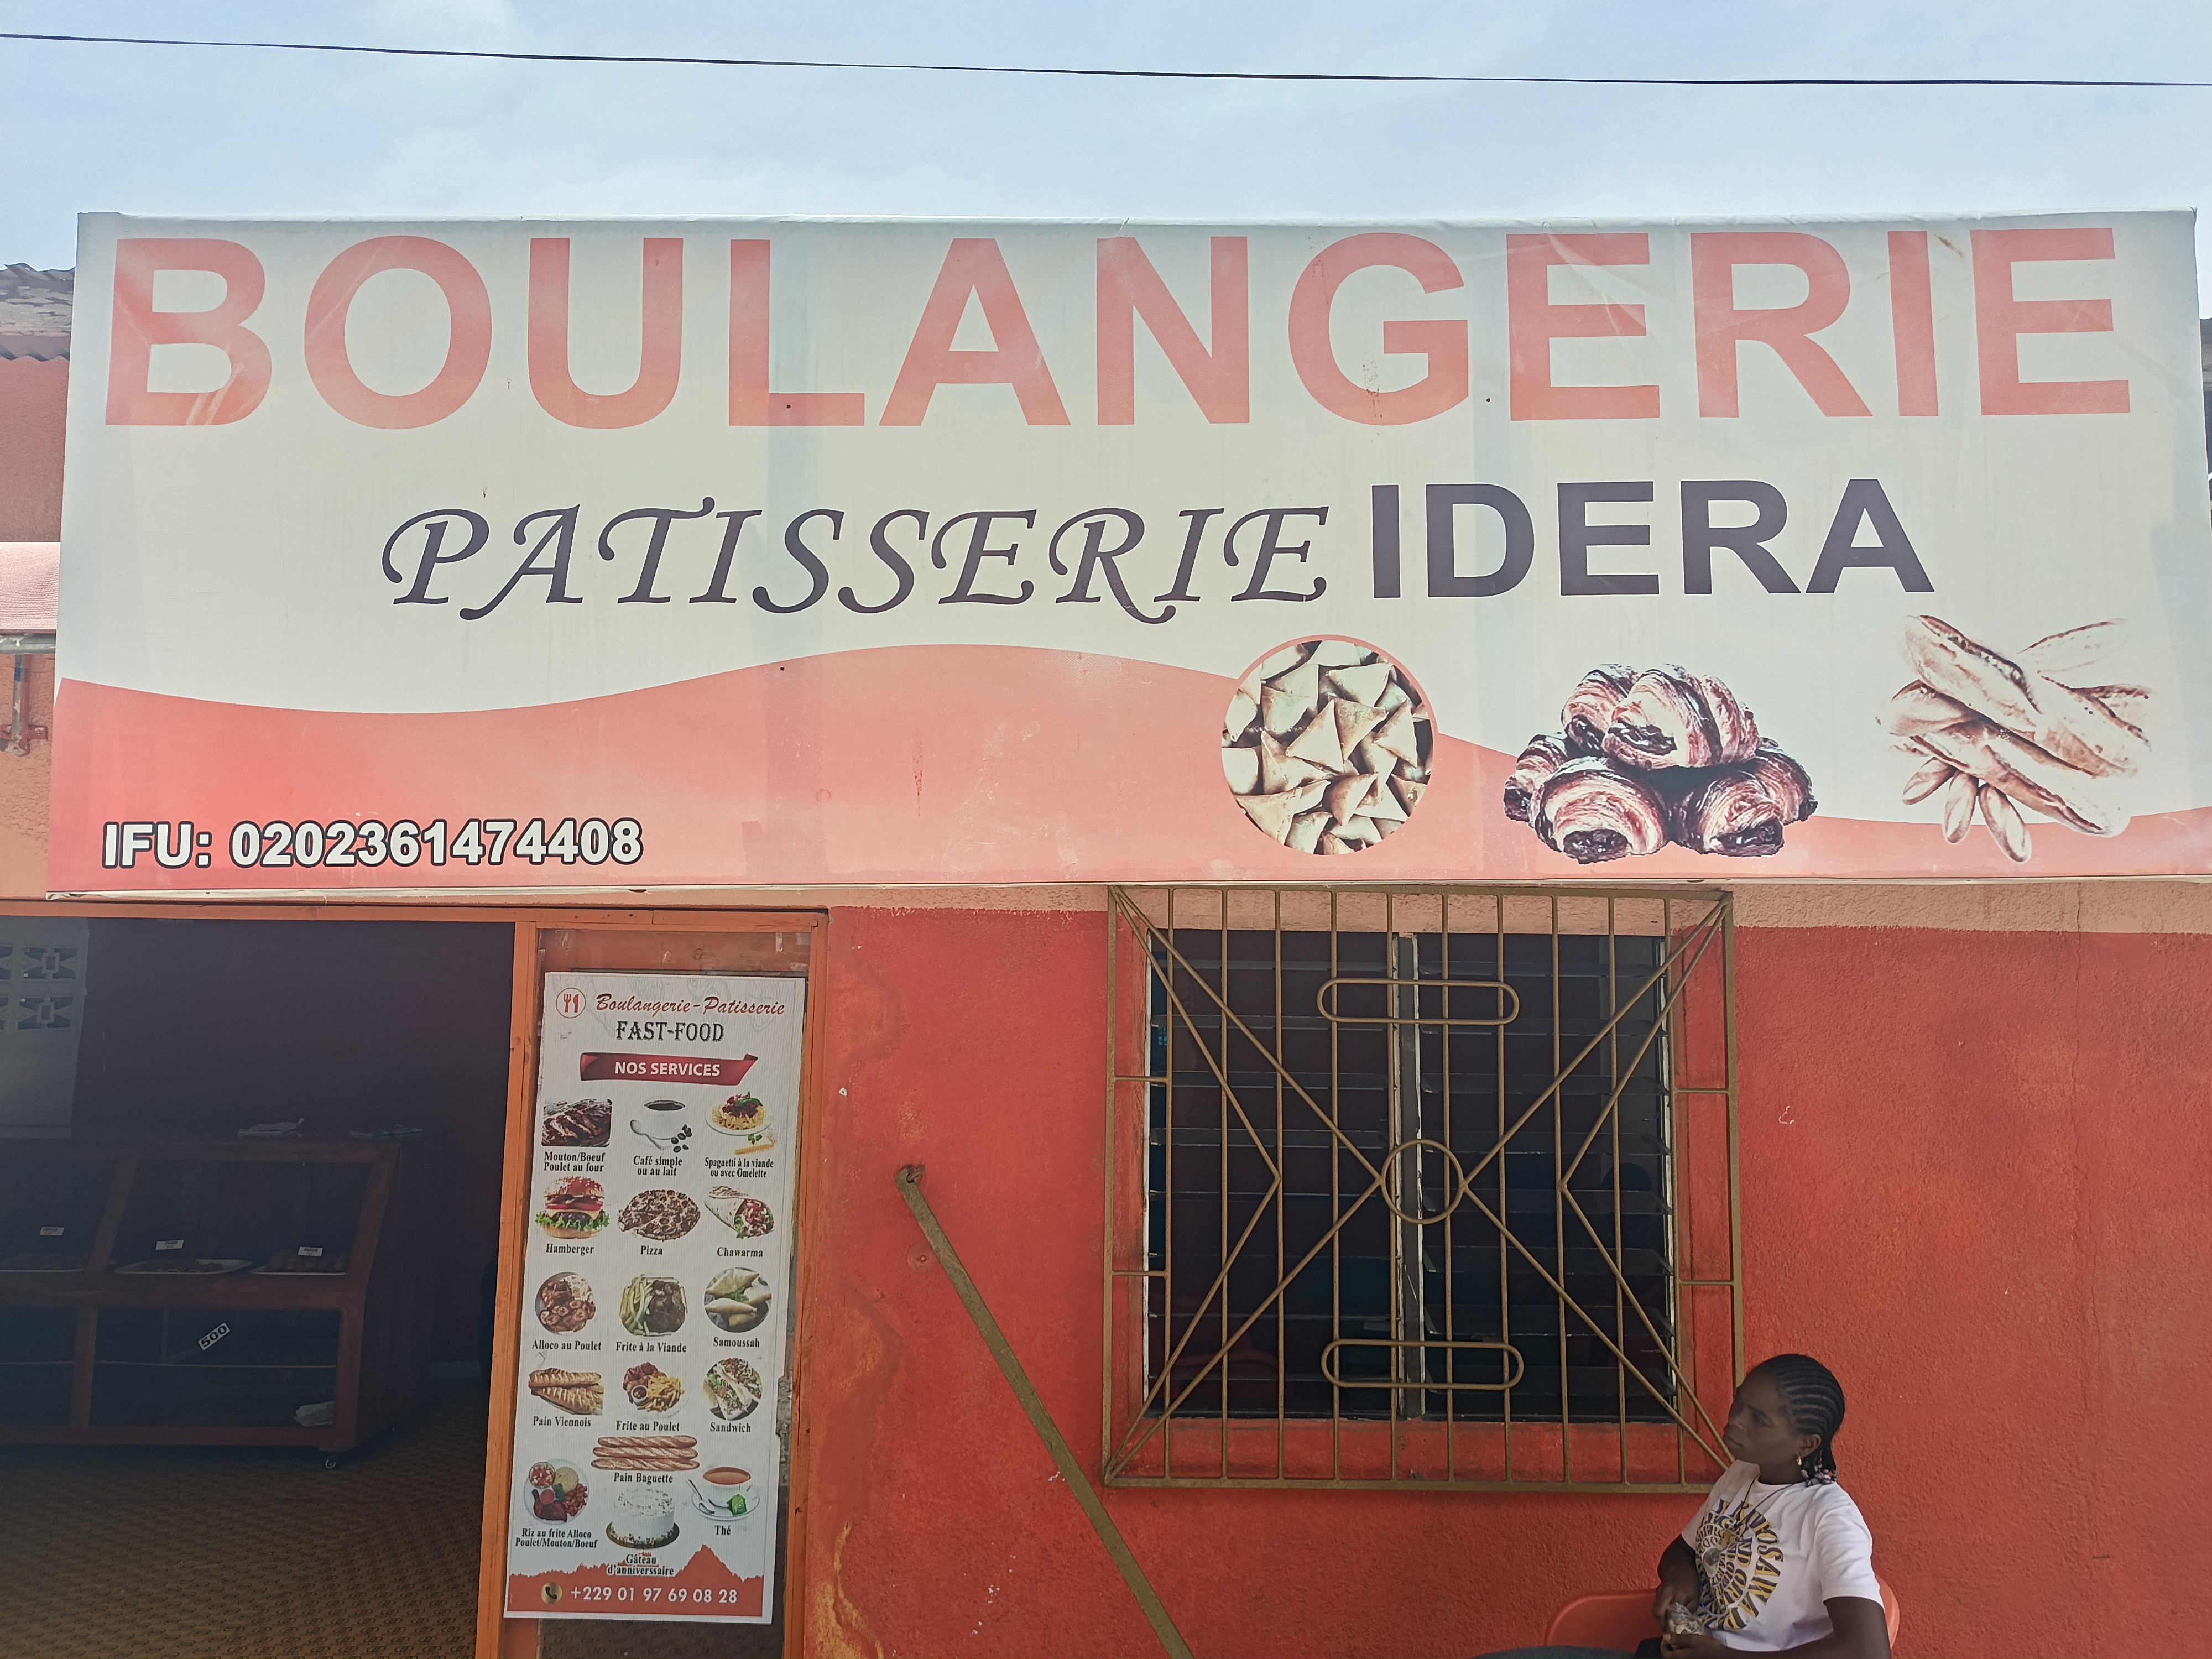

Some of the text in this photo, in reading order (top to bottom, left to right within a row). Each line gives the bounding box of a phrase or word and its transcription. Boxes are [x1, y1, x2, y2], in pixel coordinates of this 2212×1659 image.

[105, 227, 2131, 429] BOULANGERIE
[381, 478, 1936, 624] PATISSERIE IDERA
[102, 819, 644, 868] IFU: 0202361474408
[596, 993, 785, 1017] Boulangerie-Patisserie
[616, 1021, 724, 1041] FAST-FOOD
[614, 1062, 720, 1076] NOS SERVICES
[544, 1151, 606, 1162] Mouton/Boeuf
[633, 1156, 682, 1168] Café simple
[544, 1162, 570, 1171] Poulet
[586, 1162, 604, 1172] four
[705, 1157, 774, 1169] Spaguetti à la viande
[663, 1167, 676, 1176] lait
[737, 1168, 766, 1178] Omelette
[545, 1243, 594, 1255] Hamberger
[640, 1245, 662, 1256] Pizza
[717, 1246, 763, 1258] Chawarma
[201, 1325, 227, 1347] 500
[532, 1340, 559, 1350] Alloco
[575, 1340, 601, 1350] Poulet
[616, 1341, 687, 1353] Frite à la Viande
[713, 1337, 760, 1348] Samoussah
[533, 1416, 591, 1427] Pain Viennois
[616, 1420, 680, 1431] Frite au Poulet
[710, 1422, 751, 1432] Sandwich
[613, 1472, 673, 1485] Pain Baguette
[521, 1528, 535, 1537] Riz
[549, 1528, 566, 1538] frite
[567, 1528, 592, 1538] Alloco
[714, 1525, 731, 1535] Thé
[515, 1537, 598, 1548] Poulet/Mouton/Boeuf
[625, 1553, 656, 1564] Gâteau
[571, 1586, 738, 1604] +229 01 97 69 08 28
